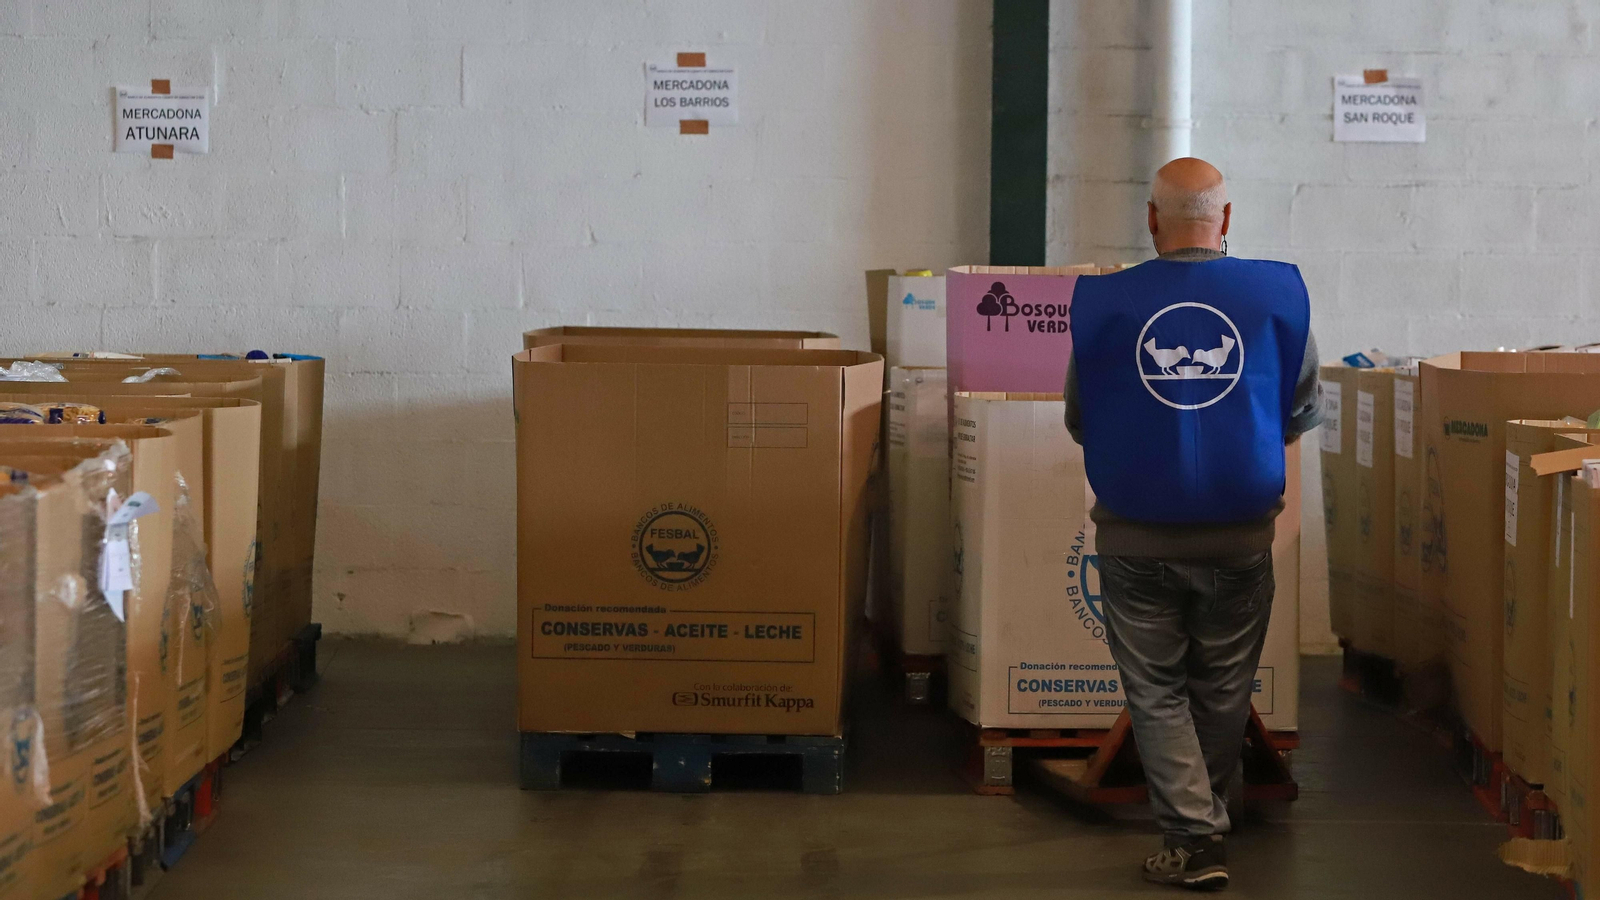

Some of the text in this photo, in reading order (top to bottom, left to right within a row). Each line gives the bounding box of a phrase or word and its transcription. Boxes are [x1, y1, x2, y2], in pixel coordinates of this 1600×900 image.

[653, 79, 730, 91] MERCADONA
[654, 97, 730, 108] LOS BARRIOS
[1341, 94, 1418, 106] MERCADONA
[122, 108, 202, 120] MERCADONA
[1343, 112, 1414, 125] SAN ROQUE
[125, 126, 200, 141] ATUNARA
[1027, 320, 1071, 333] VERD
[631, 502, 719, 543] BANCOS DE ALIMENTOS
[650, 528, 700, 540] FESBAL
[1066, 524, 1085, 567] BAN
[631, 552, 719, 592] BANCOS DE ALIMENTOS
[544, 603, 667, 614] Donación recomendada
[541, 621, 649, 637] CONSERVAS
[664, 623, 728, 638] ACEITE
[744, 625, 803, 640] LECHE
[563, 642, 676, 654] (PESCADO Y VERDURAS)
[1020, 662, 1119, 671] Donación recomend
[693, 683, 793, 692] Con la colaboración de:
[1017, 679, 1118, 693] CONSERVAS
[701, 692, 815, 712] Smurfit Kappa
[1038, 699, 1128, 709] (PESCADO Y VERDUR
